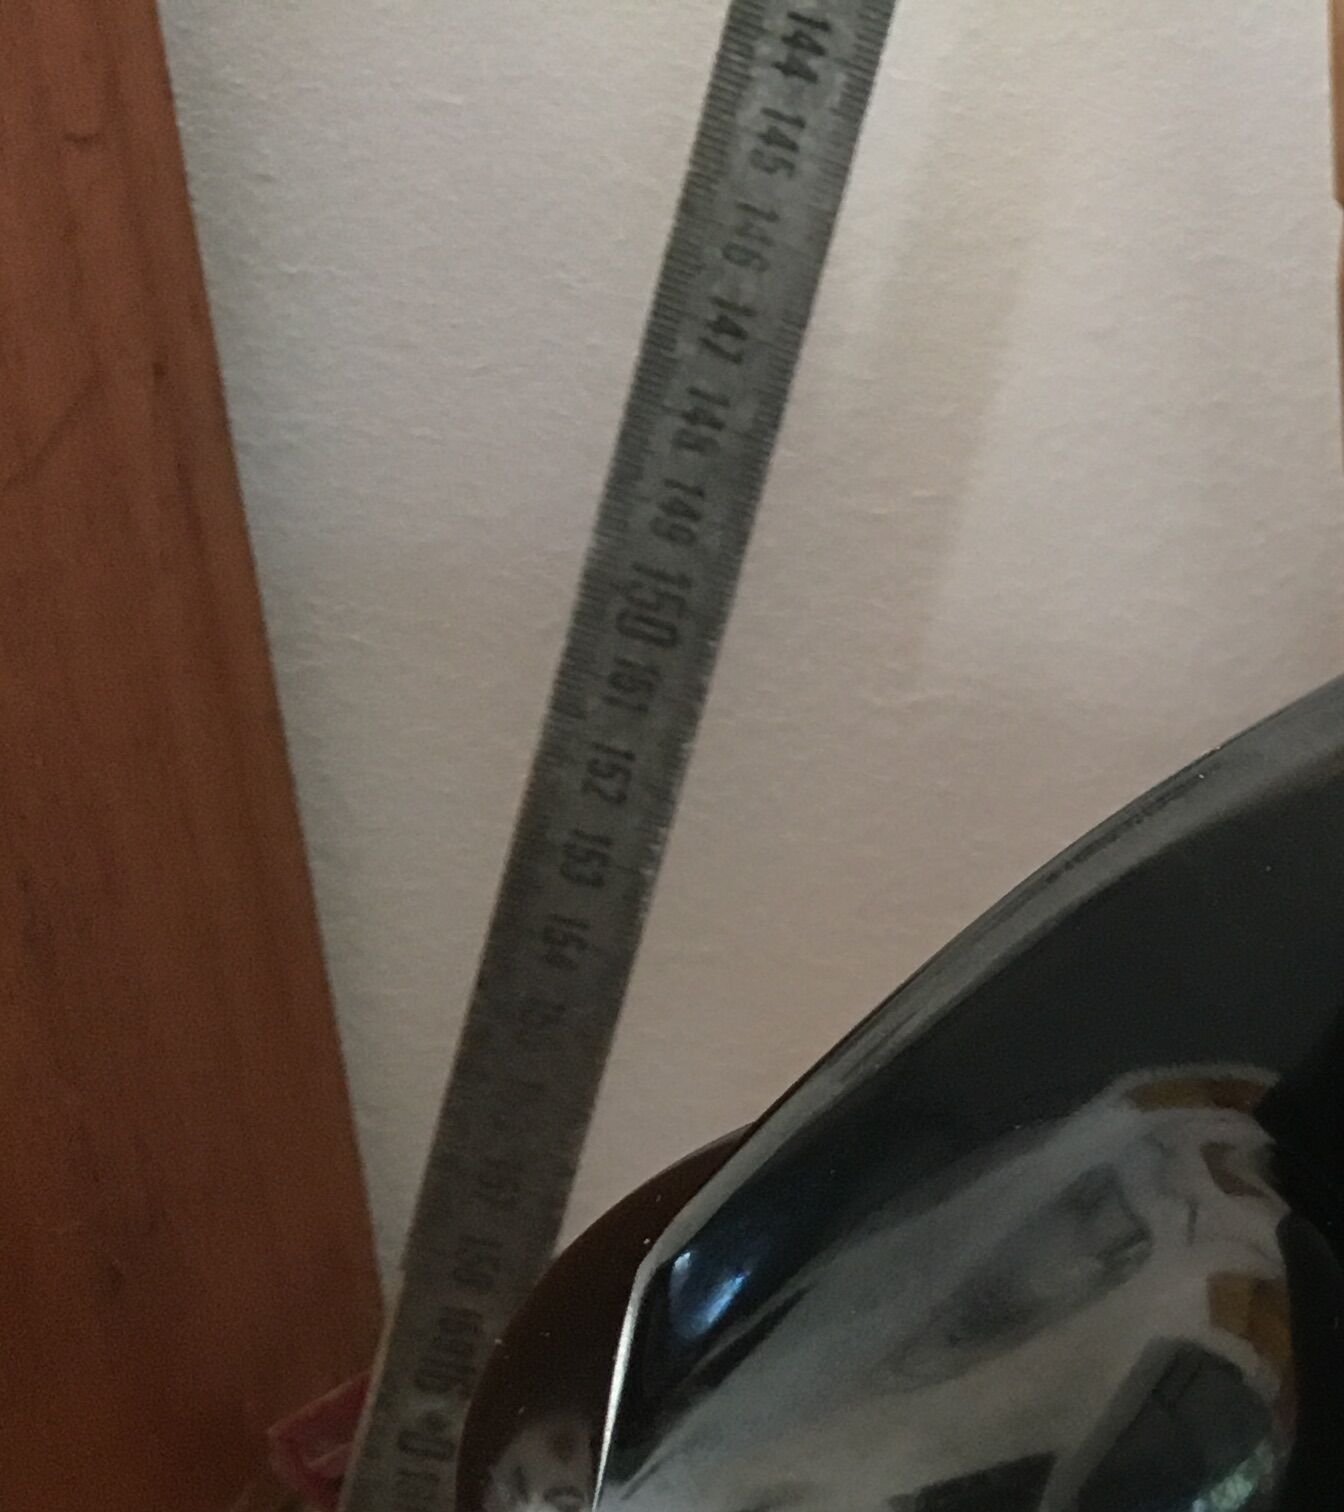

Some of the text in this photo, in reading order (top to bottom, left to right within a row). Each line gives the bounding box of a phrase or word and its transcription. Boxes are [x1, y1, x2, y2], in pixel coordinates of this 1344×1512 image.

[771, 10, 832, 86] 144
[749, 106, 806, 180] 145
[699, 297, 759, 368] 147
[616, 561, 691, 651] 150
